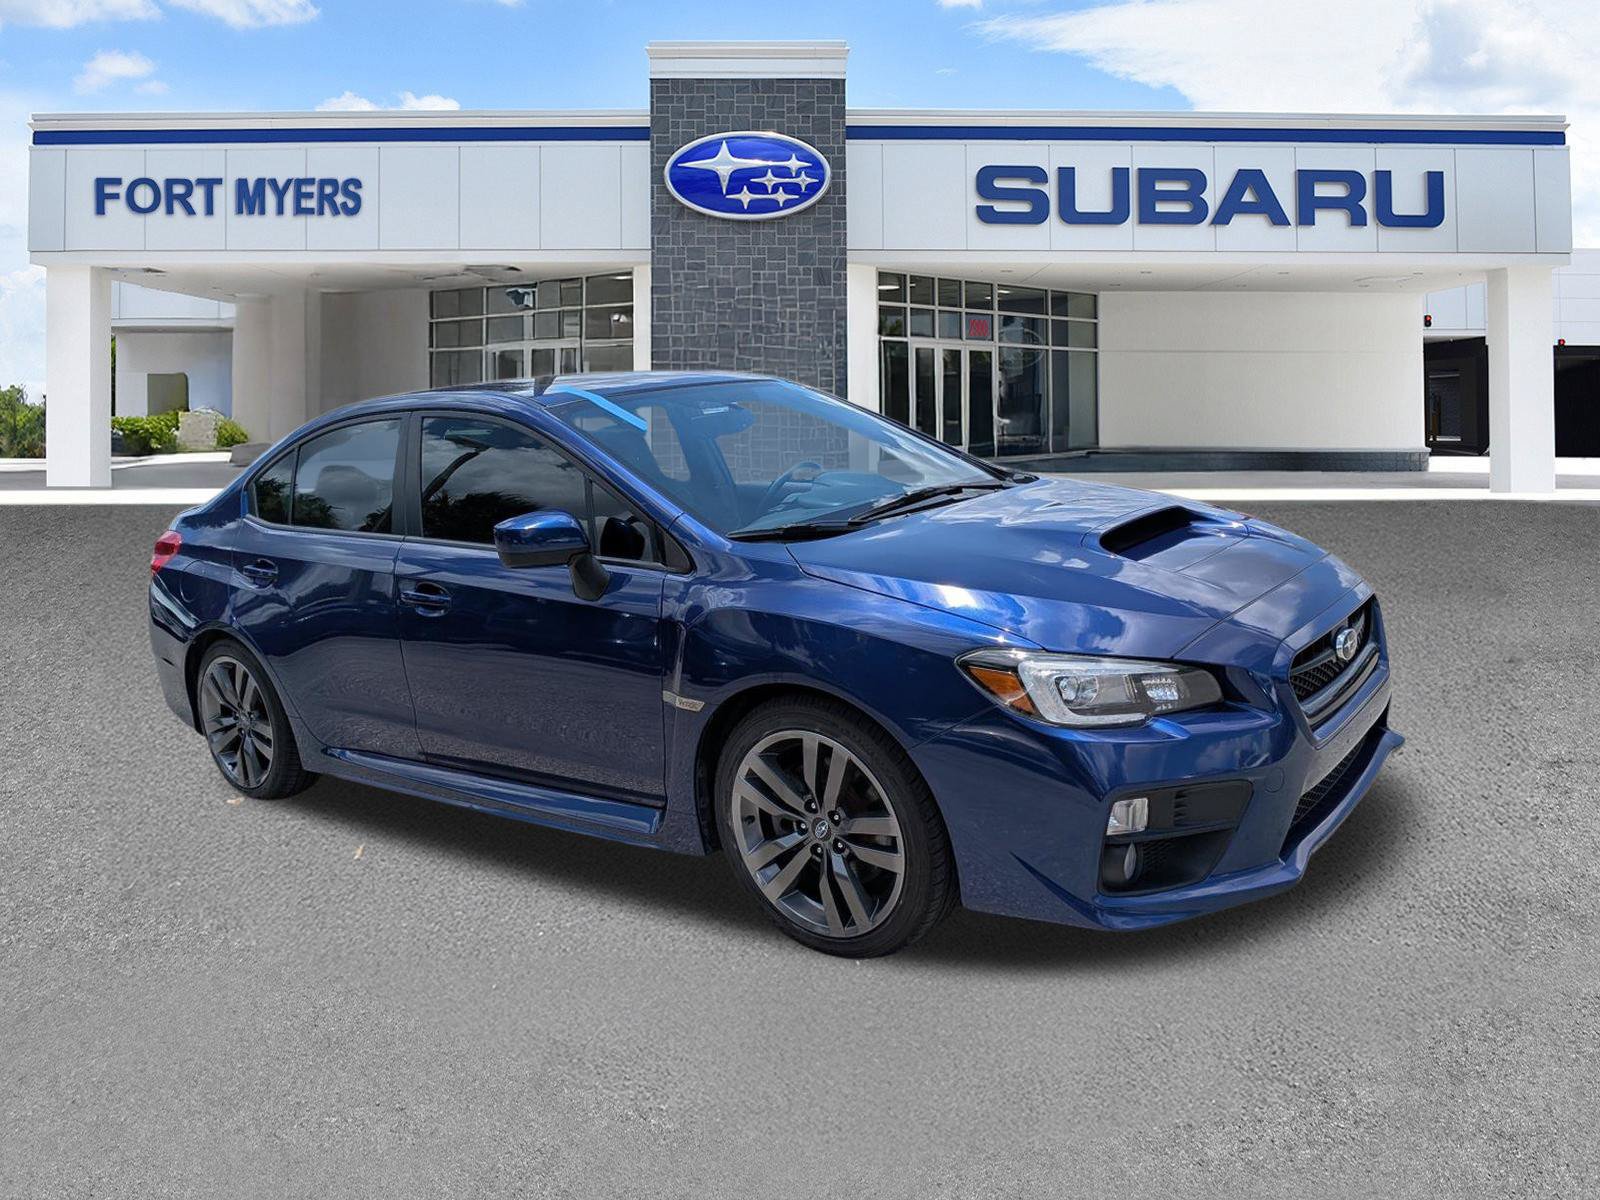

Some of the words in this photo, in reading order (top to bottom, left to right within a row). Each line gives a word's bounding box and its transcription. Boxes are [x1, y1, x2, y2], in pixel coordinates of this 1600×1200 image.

[95, 177, 223, 216] FORT
[235, 177, 363, 217] MYERS
[975, 165, 1445, 229] SUBARU
